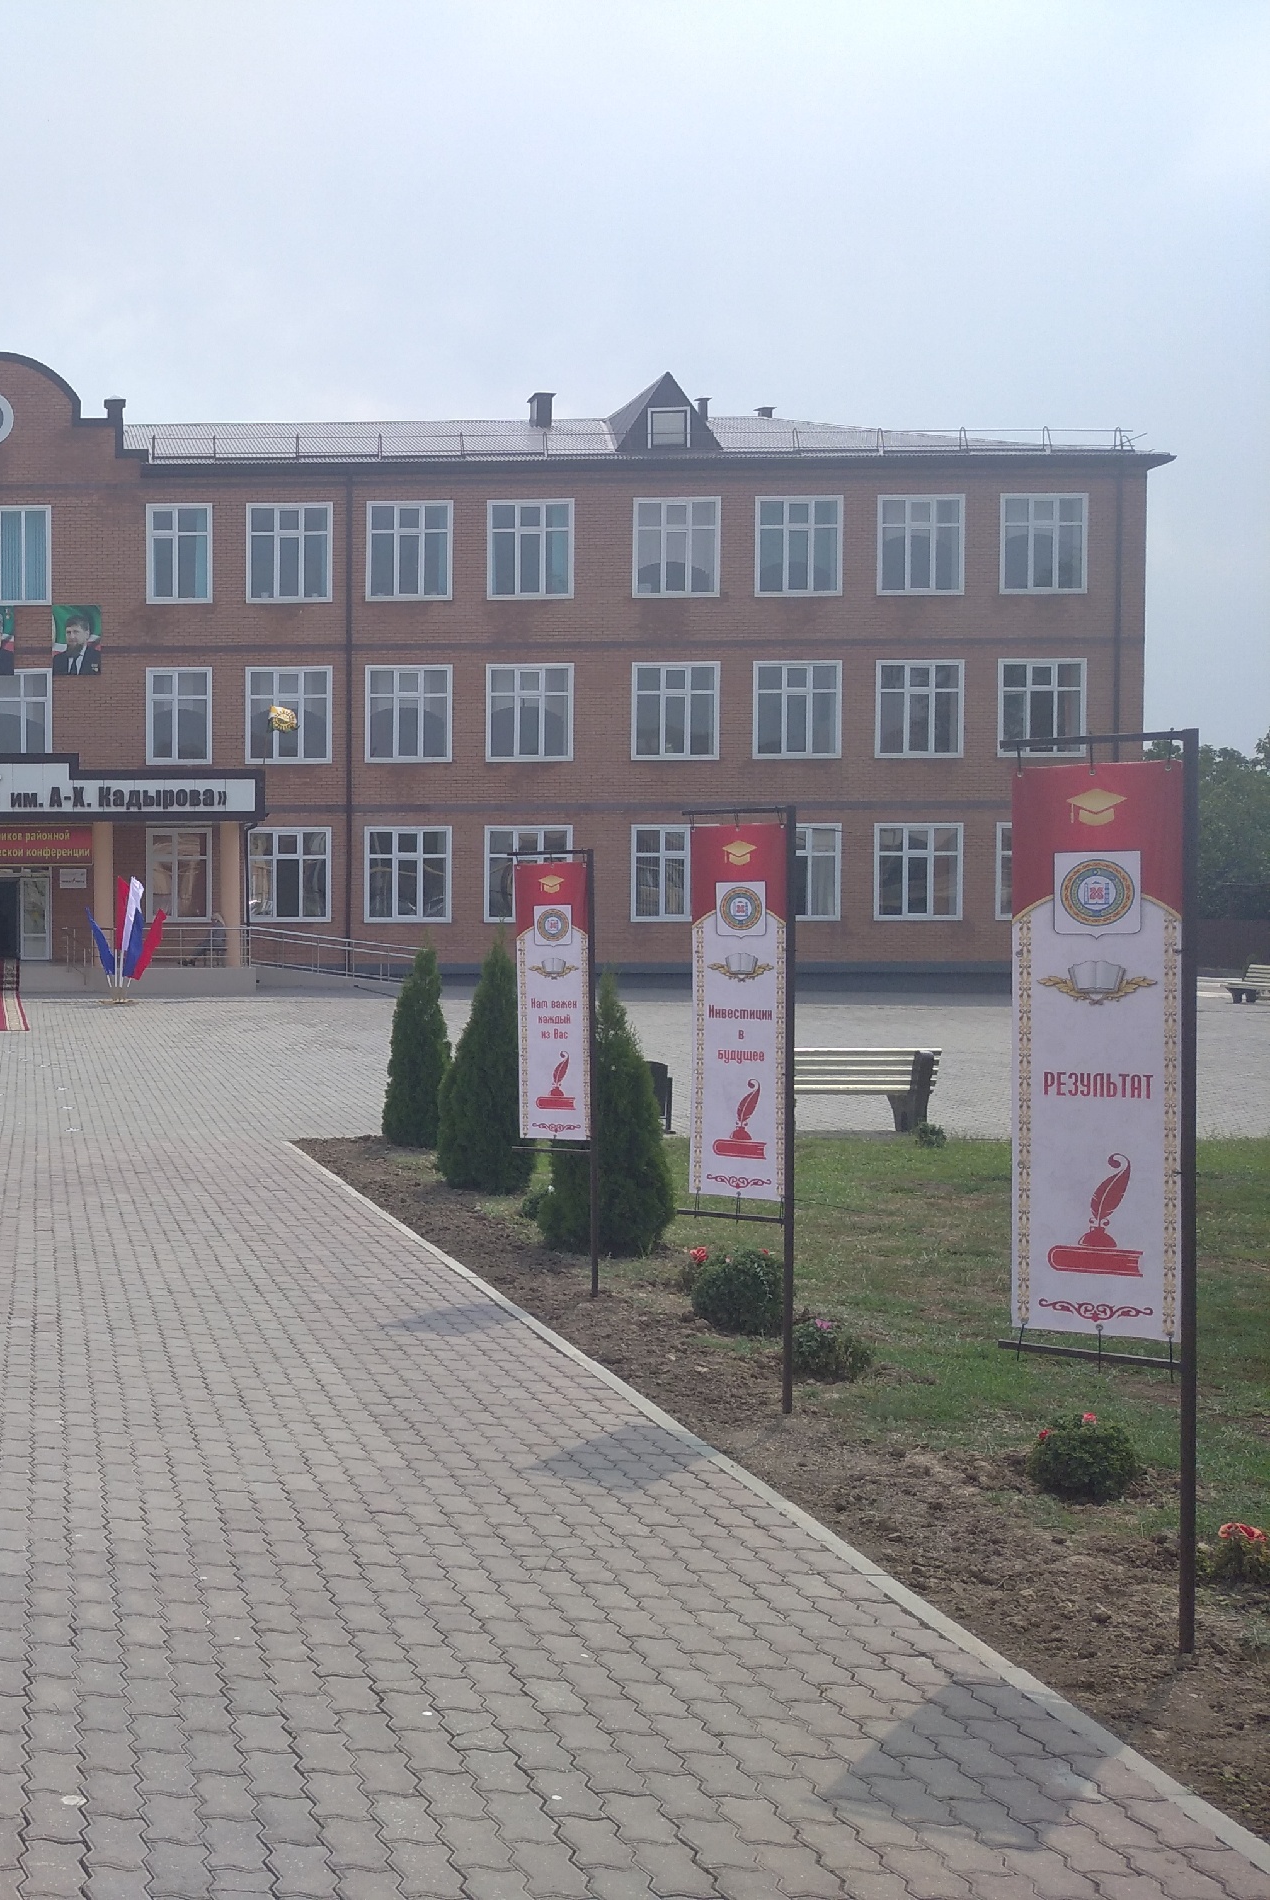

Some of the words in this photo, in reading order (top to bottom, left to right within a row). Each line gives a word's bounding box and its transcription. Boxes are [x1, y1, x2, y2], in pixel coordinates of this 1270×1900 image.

[10, 792, 44, 808] им.
[49, 786, 92, 808] А-Х.
[98, 786, 228, 810] Кадырова»
[25, 830, 70, 843] районной
[26, 847, 90, 859] конференции
[531, 998, 548, 1009] Нам
[551, 1000, 578, 1009] важен
[708, 1004, 773, 1021] Инвестиции
[538, 1014, 571, 1024] каждый
[541, 1031, 551, 1039] из
[553, 1028, 569, 1039] Вас
[738, 1029, 745, 1040] в
[717, 1049, 765, 1065] будущее
[1043, 1071, 1154, 1099] РЕЗУЛЬТАТ
